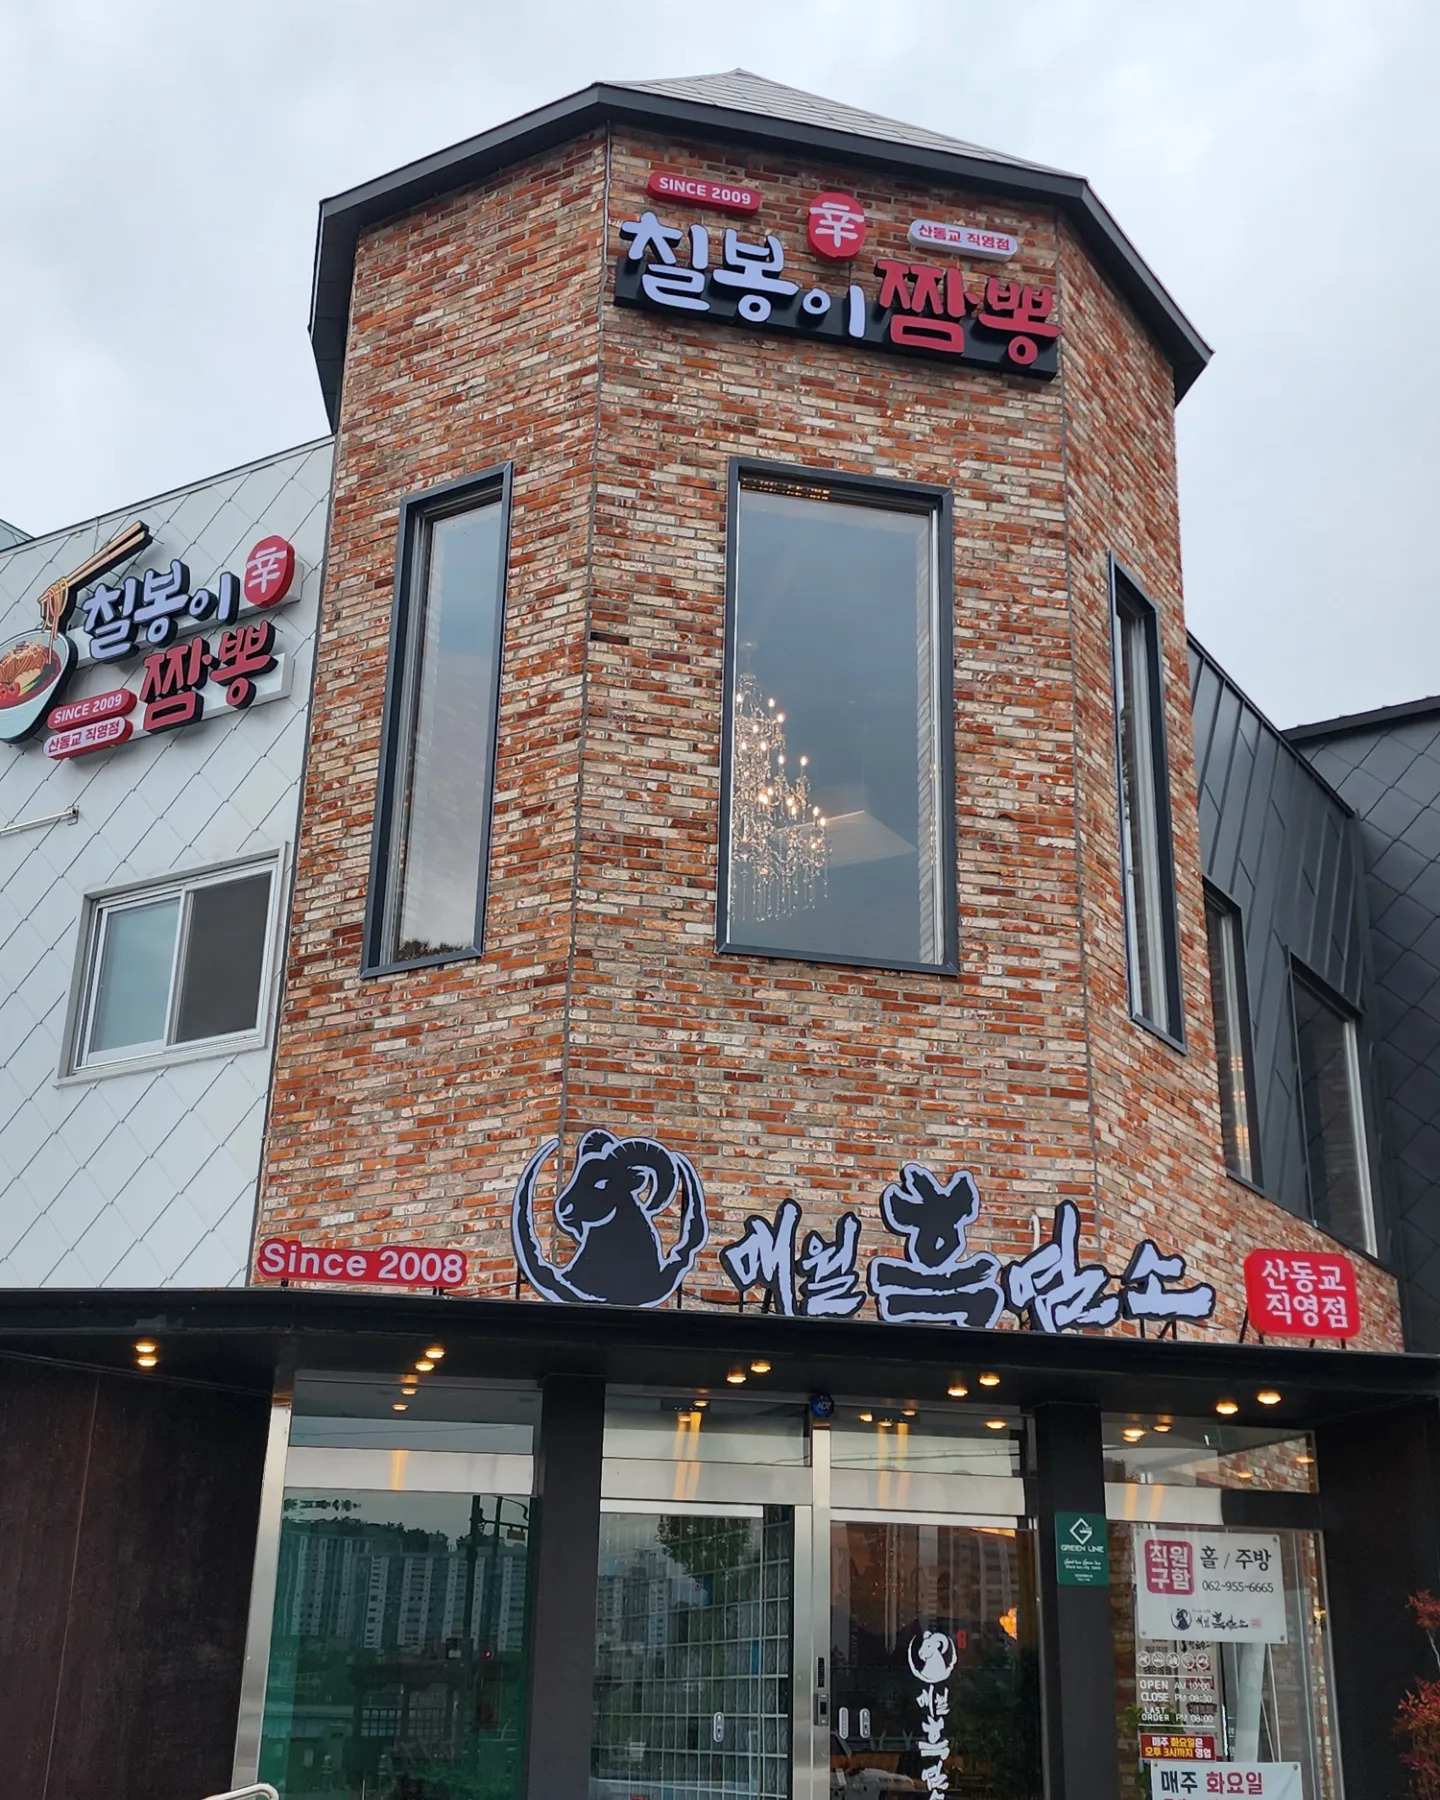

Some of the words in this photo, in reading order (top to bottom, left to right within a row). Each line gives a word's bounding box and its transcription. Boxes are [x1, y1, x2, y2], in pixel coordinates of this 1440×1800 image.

[659, 177, 706, 197] SINCE
[711, 187, 751, 205] 2009
[919, 225, 961, 243] 산동교
[967, 233, 1010, 251] 직영점
[619, 212, 866, 339] 칠봉이
[875, 259, 1062, 366] 짬뽕
[83, 559, 239, 661] 칠봉이
[139, 620, 272, 731] 짬뽕
[54, 703, 90, 724] SINCE
[92, 694, 122, 713] 2009
[48, 732, 82, 753] 산동교
[86, 720, 120, 741] 직영점
[261, 1243, 367, 1277] Since
[378, 1250, 463, 1283] 2008
[1262, 1259, 1346, 1293] 산동교
[1265, 1292, 1348, 1328] 직영점
[1087, 1545, 1105, 1553] LINE
[1150, 1544, 1188, 1568] 직원
[1200, 1545, 1218, 1569] 홀
[1236, 1548, 1272, 1571] 주방
[1151, 1567, 1190, 1590] 구함
[1202, 1580, 1274, 1593] 062-955-6665
[1140, 1680, 1168, 1689] OPEN
[1141, 1692, 1170, 1702] CLOSE
[1160, 1771, 1198, 1794] 매주
[1206, 1771, 1263, 1795] 화요일
